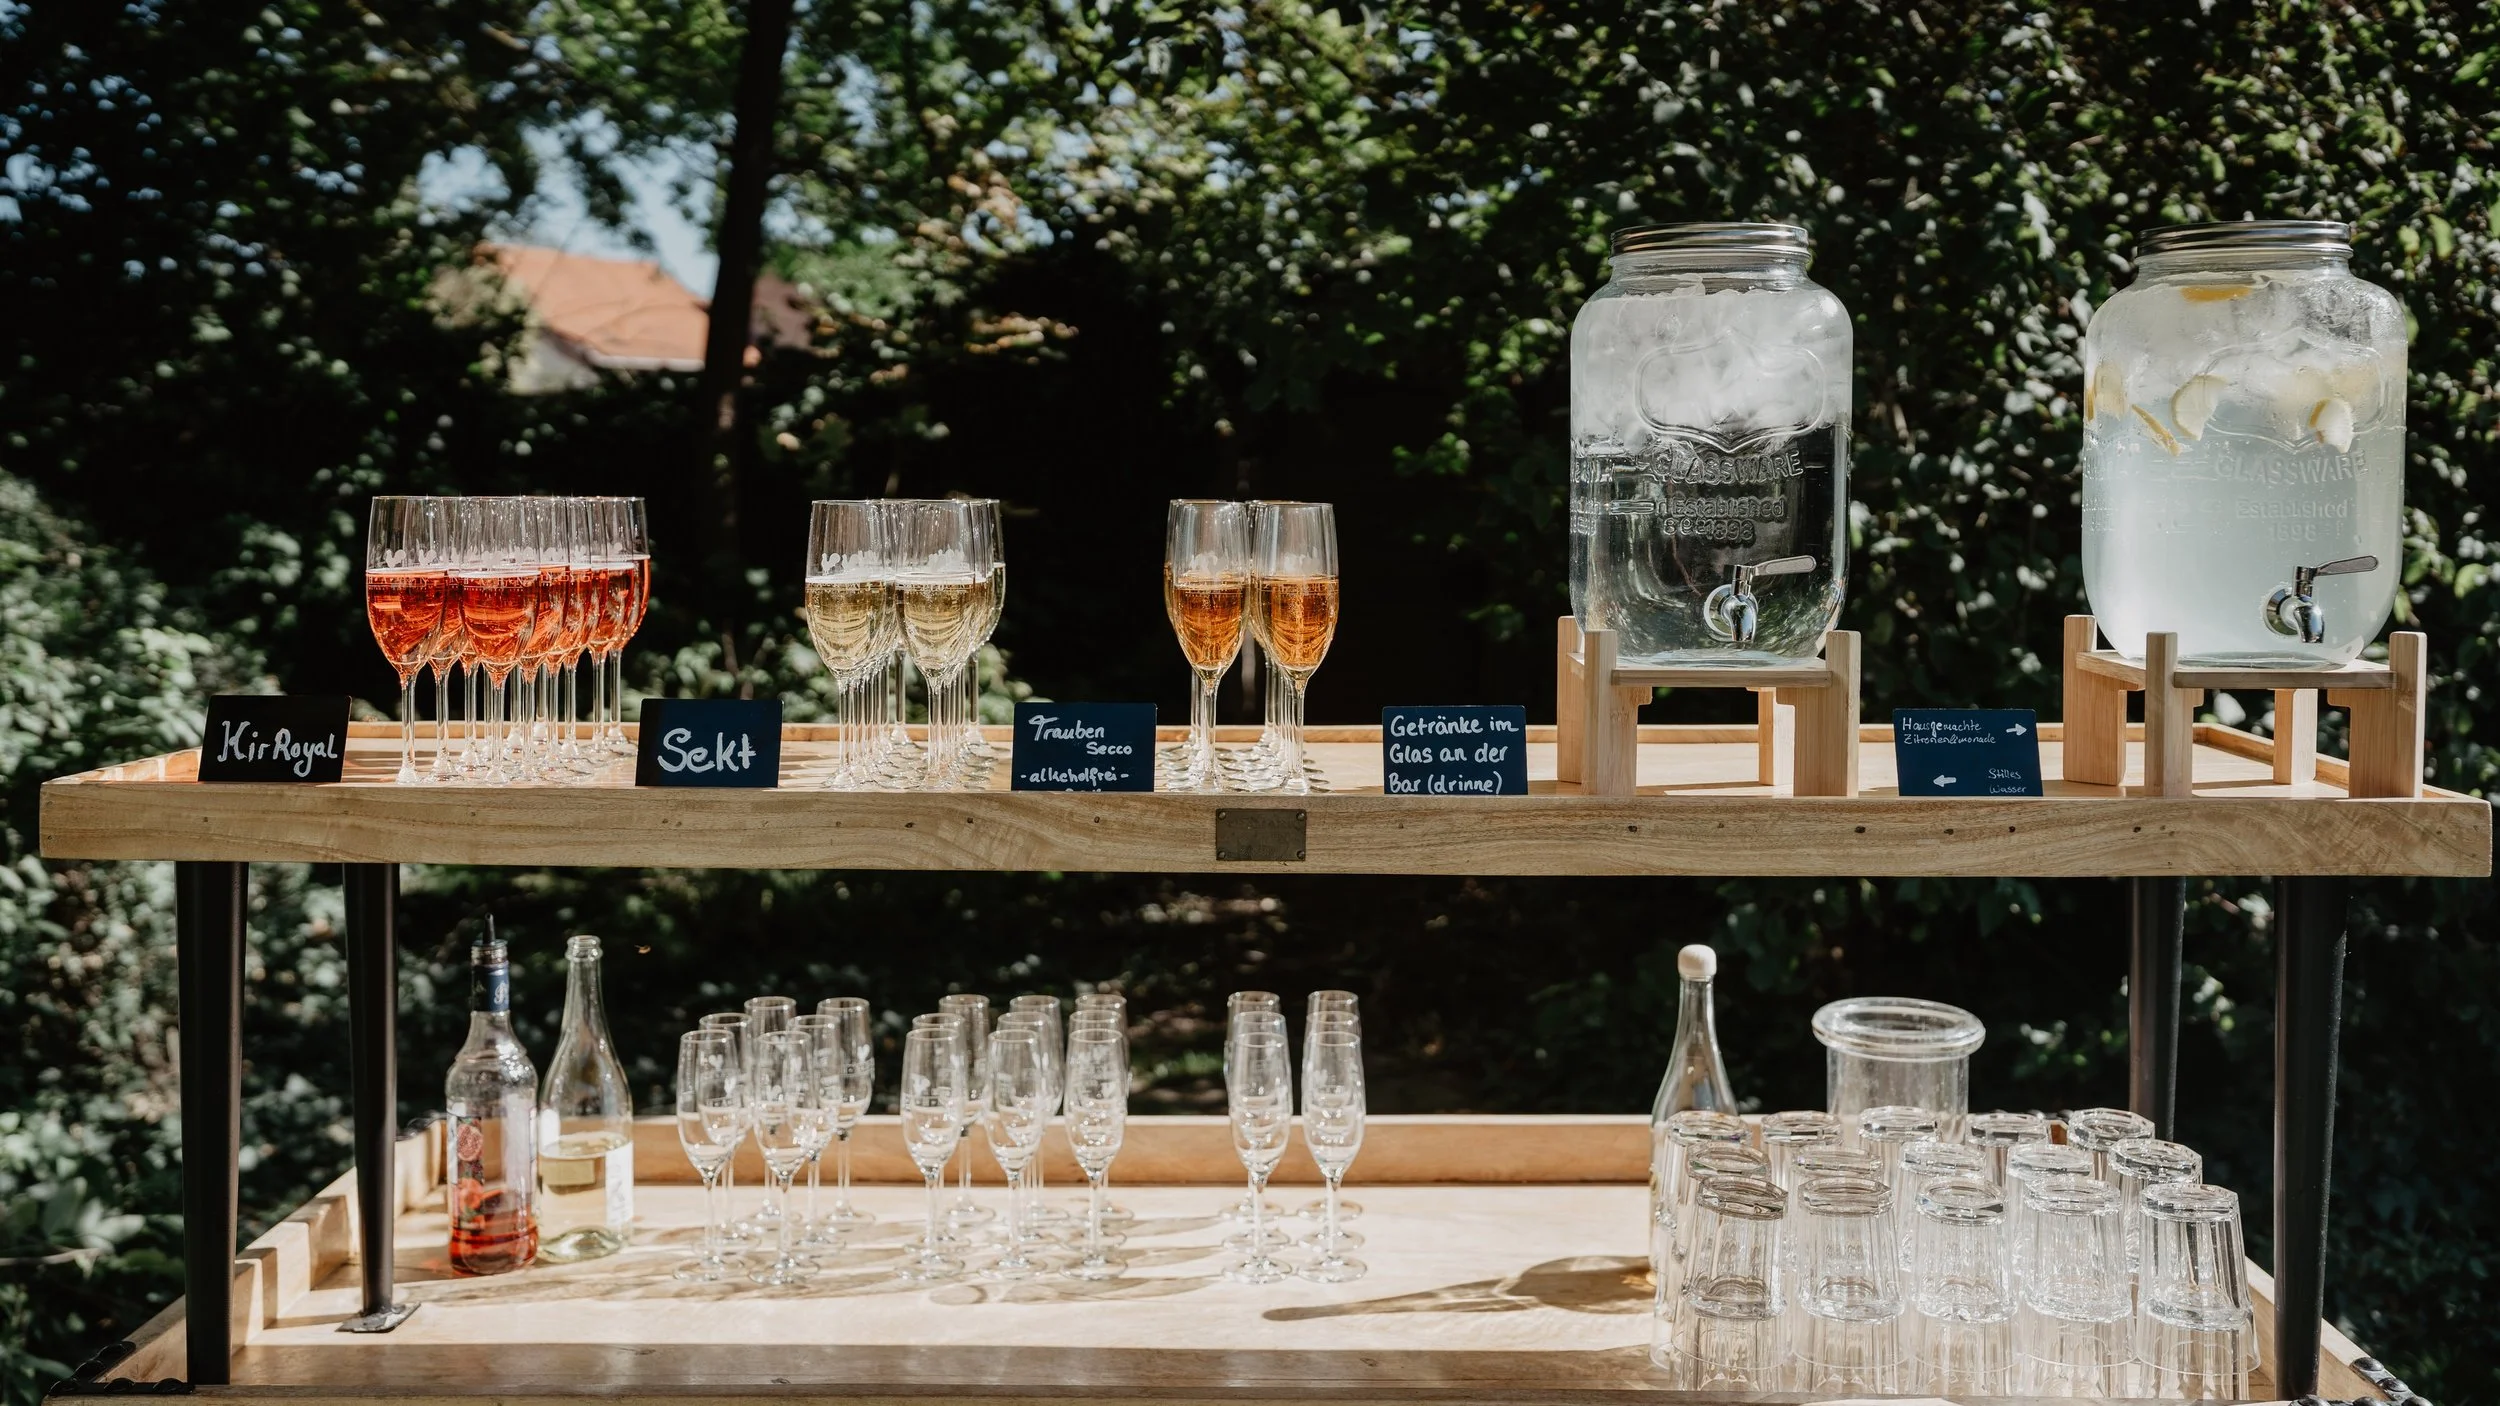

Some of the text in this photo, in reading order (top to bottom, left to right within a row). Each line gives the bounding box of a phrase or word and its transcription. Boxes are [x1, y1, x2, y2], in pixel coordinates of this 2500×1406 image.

[1651, 450, 1803, 484] GLASSWARE
[2215, 450, 2368, 485] GLASSWARE
[1028, 714, 1105, 741] Trauben
[1390, 714, 1519, 737] Getränke im
[1902, 716, 1982, 738] Hausgemachte
[217, 720, 338, 778] Kir Royal
[657, 727, 757, 774] Sekt
[1085, 741, 1133, 756] Secco
[1389, 742, 1508, 763] Glas an der
[1388, 770, 1503, 795] Bar (drinne)
[1988, 767, 2022, 780] Stilles
